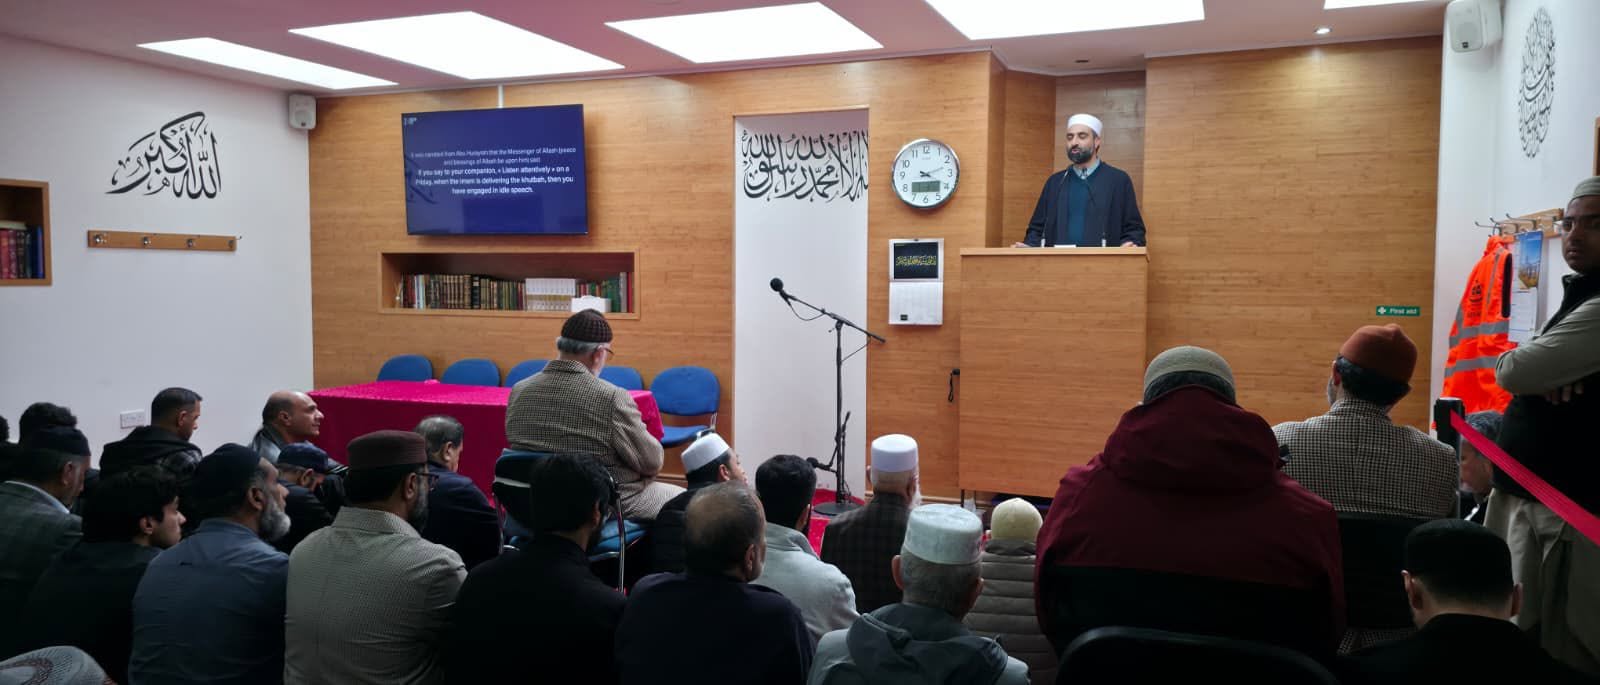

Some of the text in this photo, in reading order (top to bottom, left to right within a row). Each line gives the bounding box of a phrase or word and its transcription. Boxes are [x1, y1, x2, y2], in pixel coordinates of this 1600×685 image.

[923, 145, 930, 154] 12
[938, 148, 942, 156] 1
[912, 150, 918, 158] 11
[944, 155, 951, 164] 2
[902, 160, 910, 168] 10
[900, 172, 906, 180] 9
[948, 168, 952, 178] 3
[466, 186, 492, 194] engaged
[902, 184, 908, 192] 8
[922, 195, 928, 204] 6
[936, 192, 941, 200] 5
